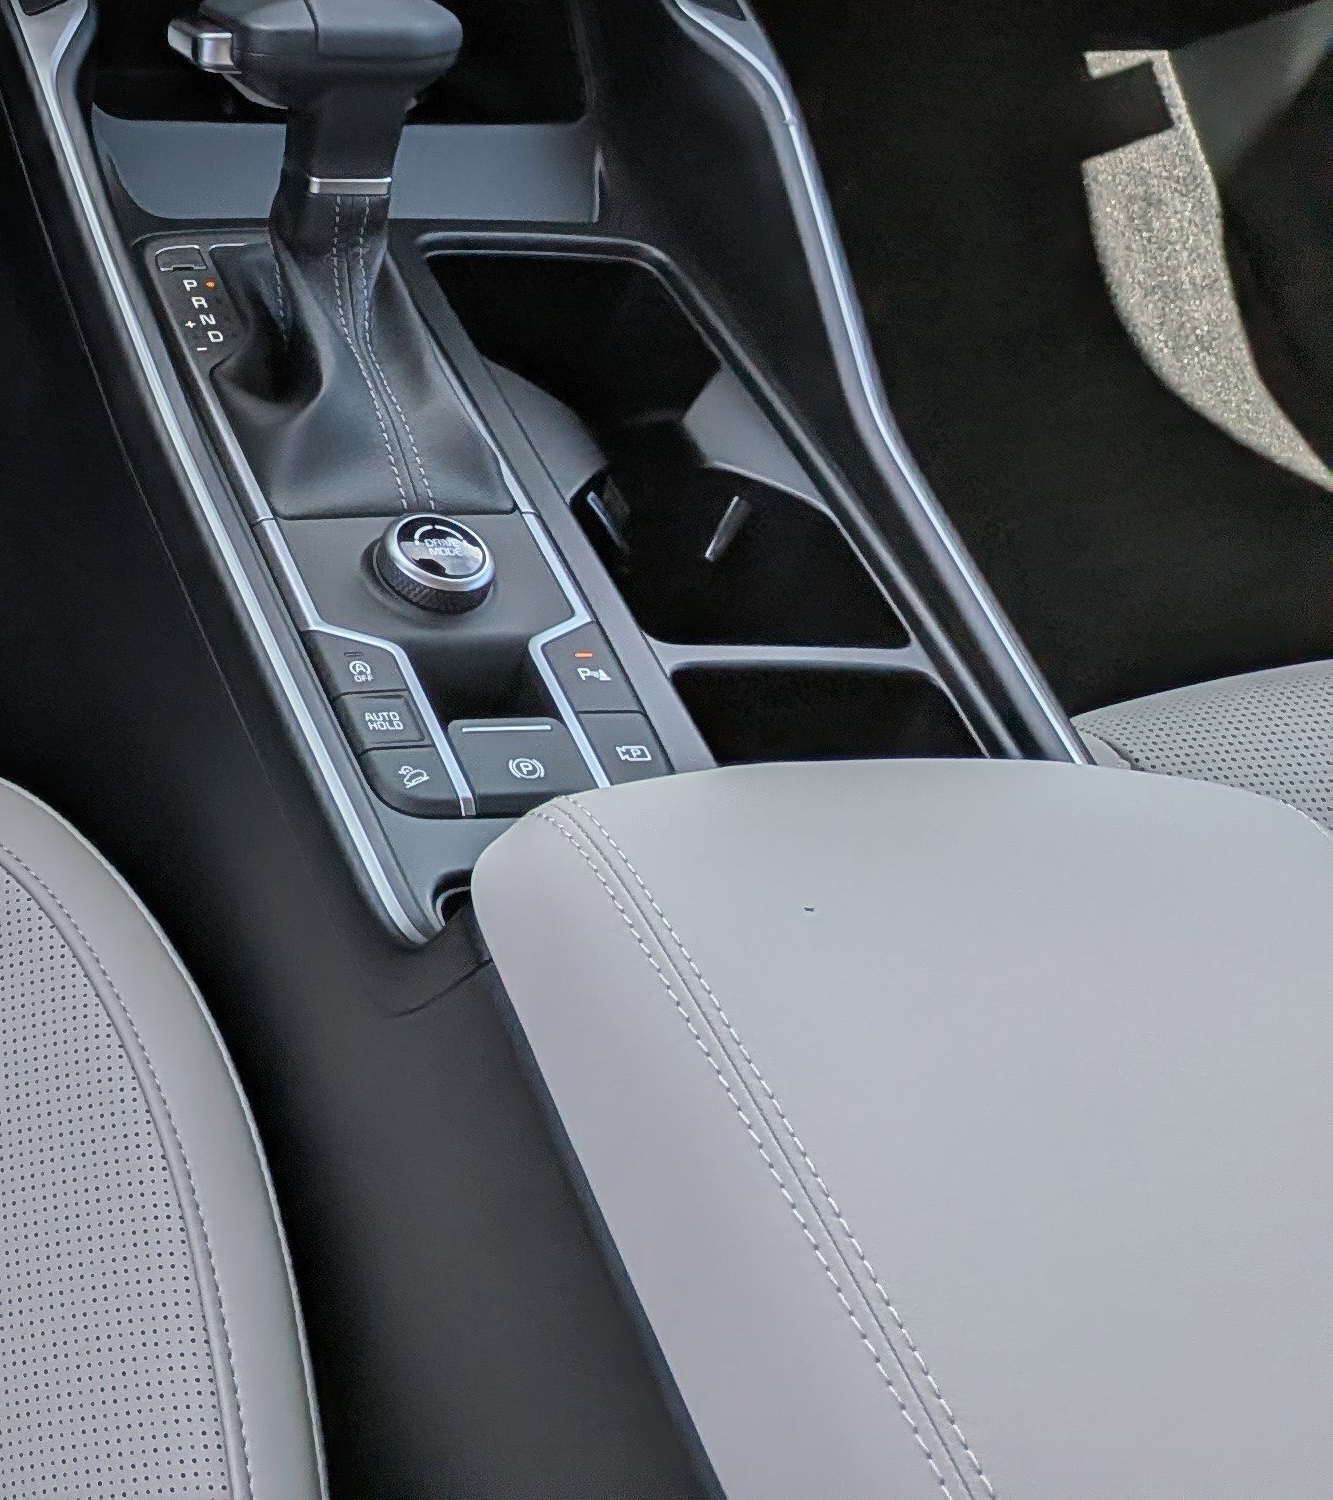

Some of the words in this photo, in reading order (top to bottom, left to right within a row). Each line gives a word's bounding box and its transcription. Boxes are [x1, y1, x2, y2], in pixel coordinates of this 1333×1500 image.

[183, 279, 198, 291] P
[191, 296, 209, 309] R
[199, 313, 217, 326] N
[207, 330, 224, 343] D
[354, 674, 374, 683] OFF
[365, 711, 400, 722] AUTO
[368, 721, 404, 731] HOLD
